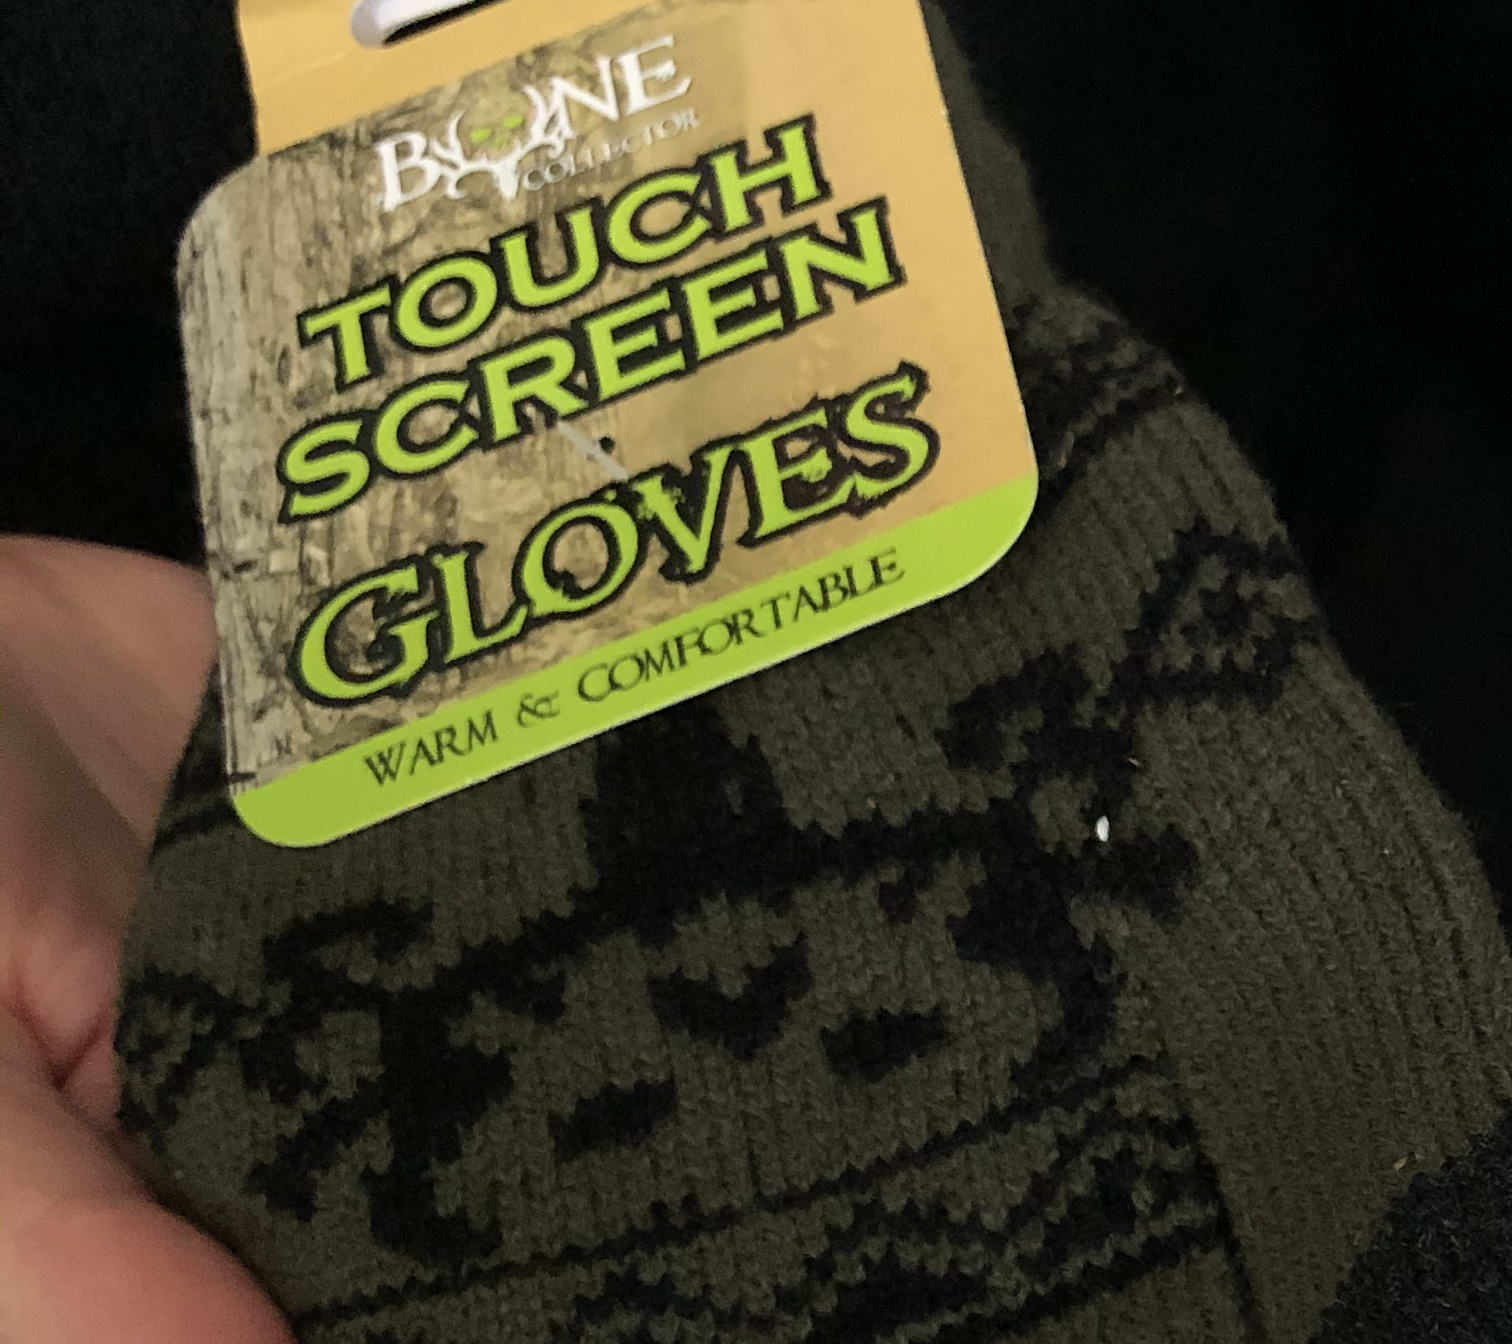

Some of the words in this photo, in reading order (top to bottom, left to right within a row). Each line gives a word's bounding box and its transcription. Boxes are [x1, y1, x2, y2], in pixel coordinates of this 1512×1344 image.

[276, 194, 908, 524] SCREEN
[298, 113, 831, 387] TOUCH
[287, 362, 940, 710] GLOVES
[363, 709, 499, 787] WARM
[516, 690, 561, 727] &
[576, 546, 906, 703] COMFORTABLE
